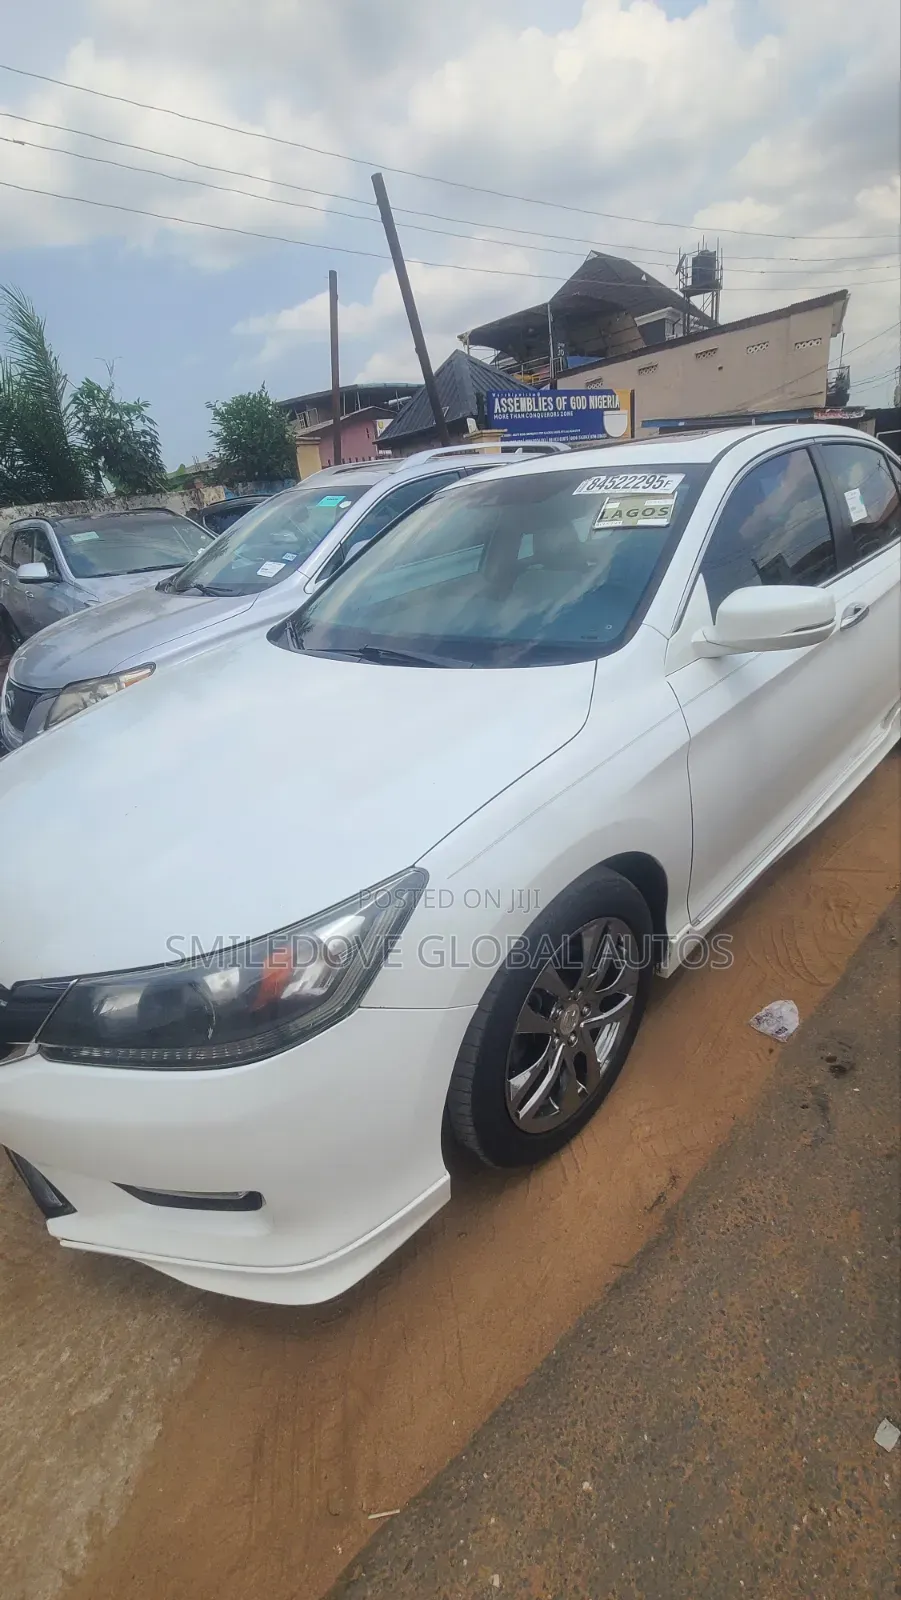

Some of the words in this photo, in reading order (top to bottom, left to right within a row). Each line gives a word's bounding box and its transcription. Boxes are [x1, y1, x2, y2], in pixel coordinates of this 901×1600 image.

[494, 397, 554, 414] ASSEMBLIES
[555, 396, 567, 411] OF
[570, 395, 587, 410] GOD
[589, 394, 620, 409] NIGERIA
[525, 411, 559, 419] CONQUERORS
[600, 506, 670, 520] LAGOS
